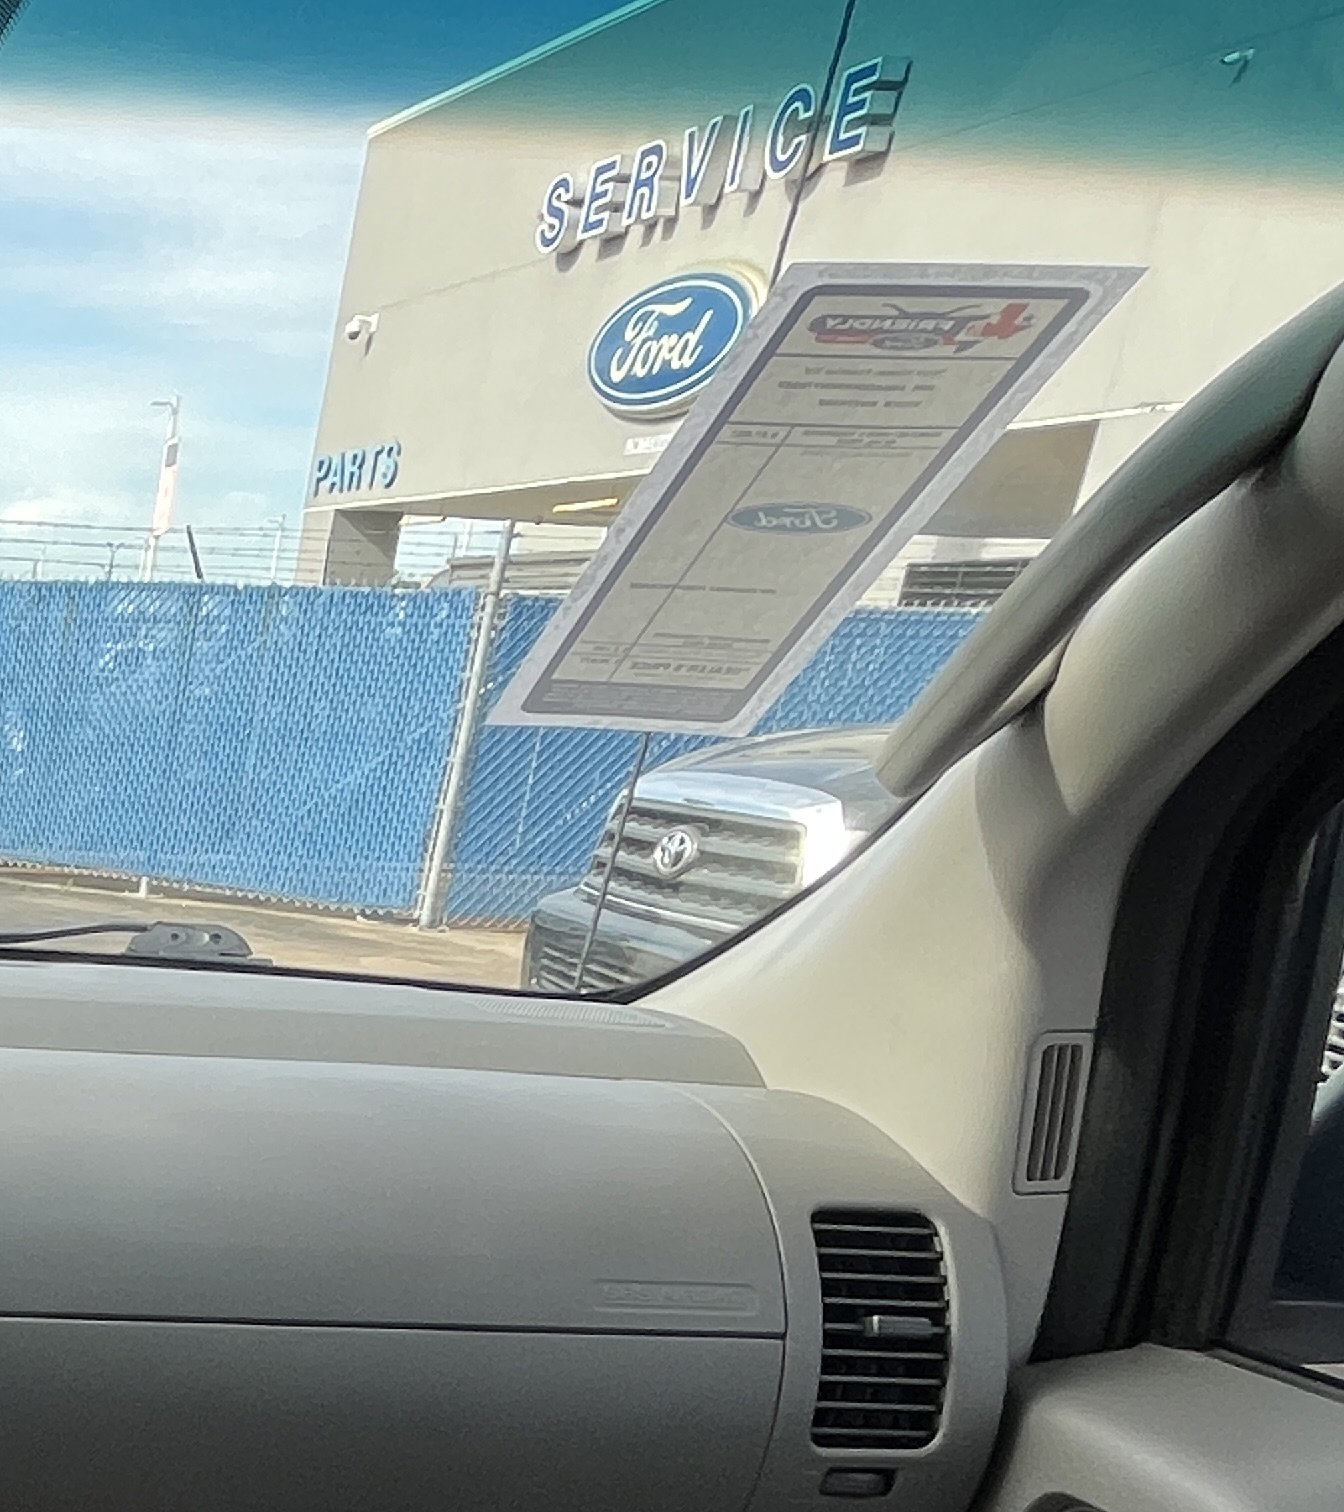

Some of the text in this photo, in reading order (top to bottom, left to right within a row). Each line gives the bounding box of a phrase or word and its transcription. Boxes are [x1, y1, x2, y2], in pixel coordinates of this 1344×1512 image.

[535, 56, 884, 254] SERVICE
[610, 296, 714, 384] Ford
[313, 440, 402, 498] PARTS
